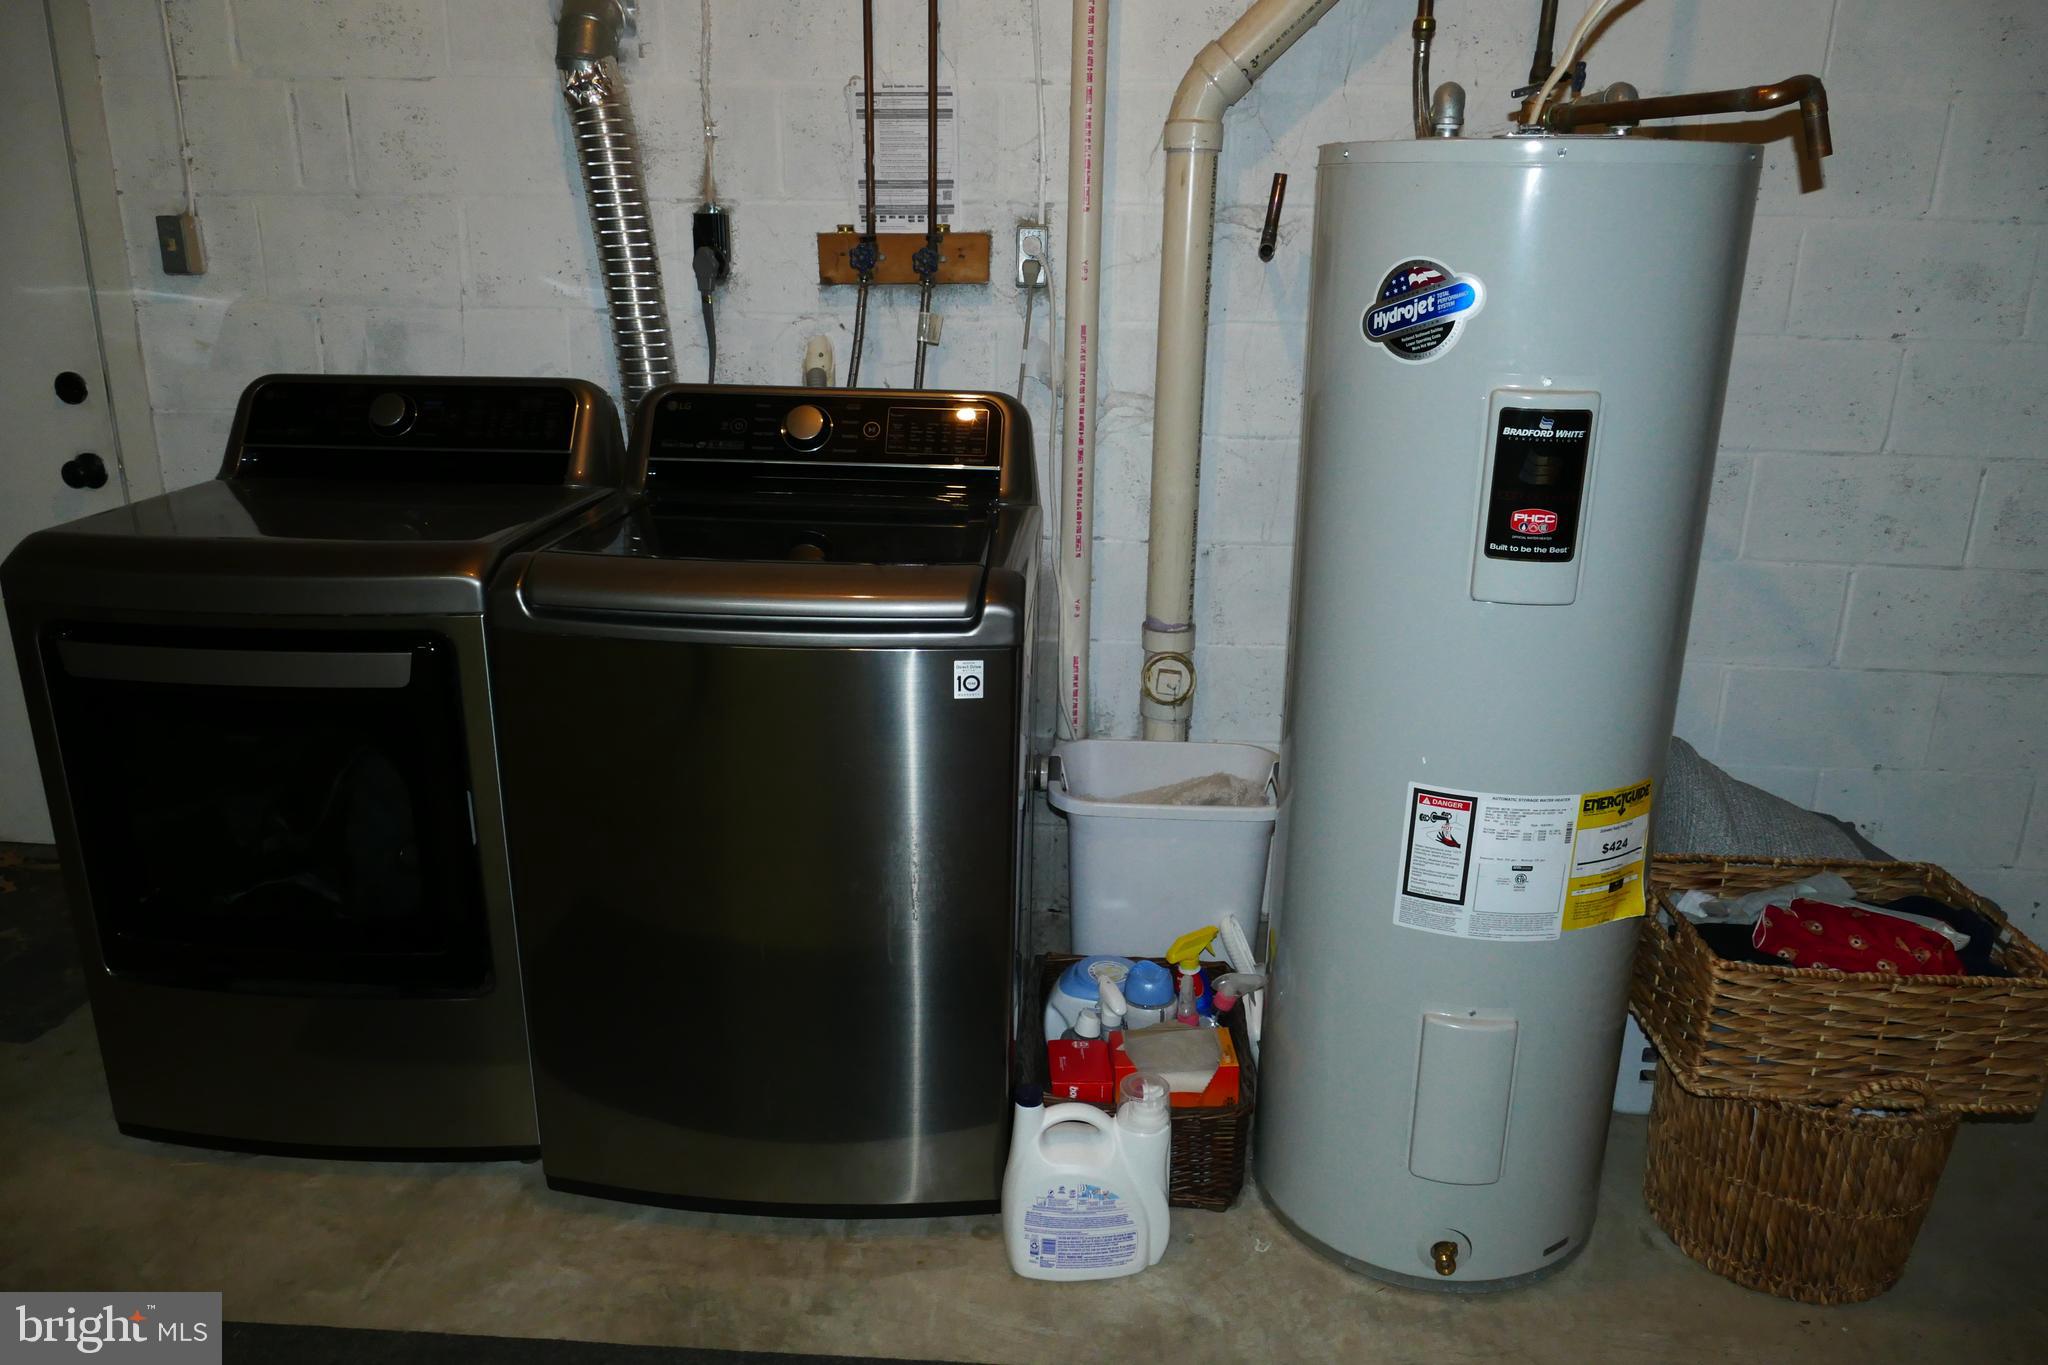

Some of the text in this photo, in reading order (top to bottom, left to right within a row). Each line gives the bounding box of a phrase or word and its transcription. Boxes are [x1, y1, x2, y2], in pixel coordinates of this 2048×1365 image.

[1373, 295, 1435, 331] Hydrojet
[680, 402, 692, 410] LG
[1503, 427, 1584, 438] BRADFORD WHITE
[1513, 513, 1556, 523] PHCC
[1490, 543, 1508, 551] Built
[957, 675, 980, 692] 10
[1432, 798, 1463, 809] DANGER
[1602, 838, 1628, 854] $424
